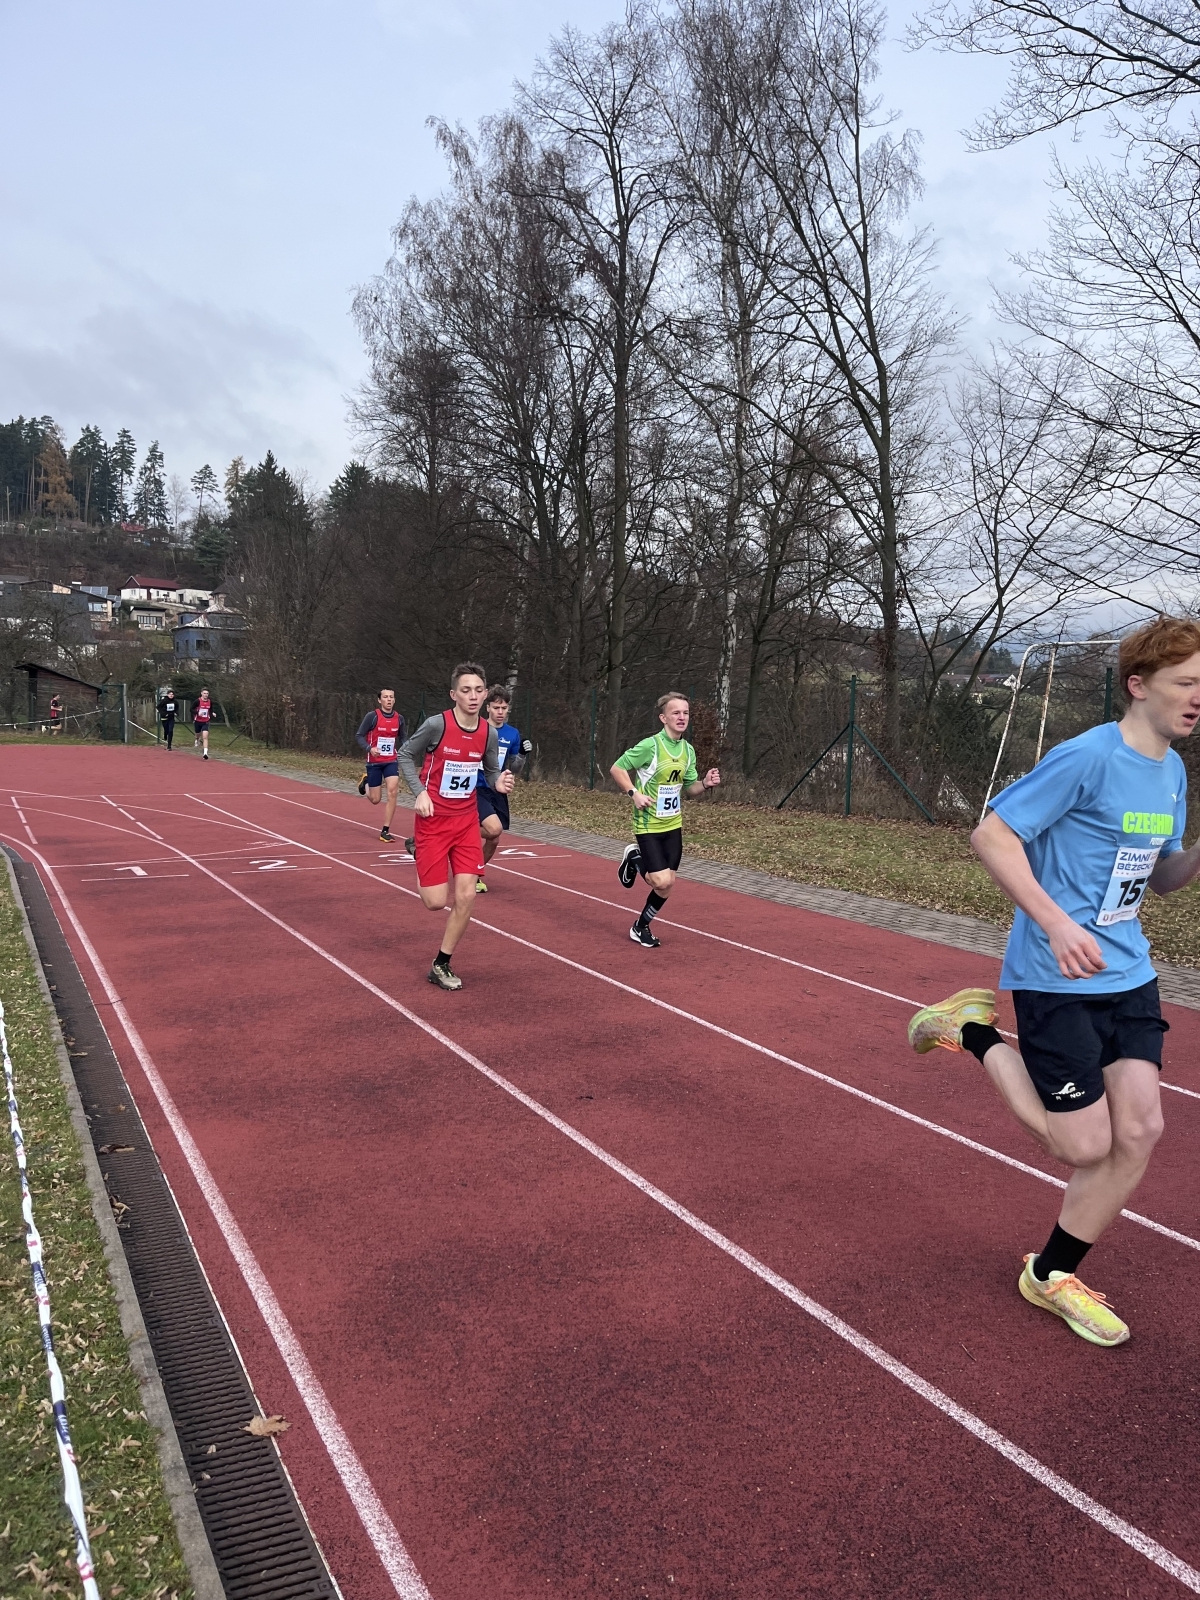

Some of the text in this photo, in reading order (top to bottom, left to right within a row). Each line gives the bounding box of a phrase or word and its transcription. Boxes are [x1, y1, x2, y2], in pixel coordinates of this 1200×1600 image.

[449, 776, 470, 790] 54
[664, 797, 678, 810] 50
[1119, 851, 1152, 862] ZIMNÍ
[249, 859, 299, 869] 2
[113, 865, 148, 876] 1
